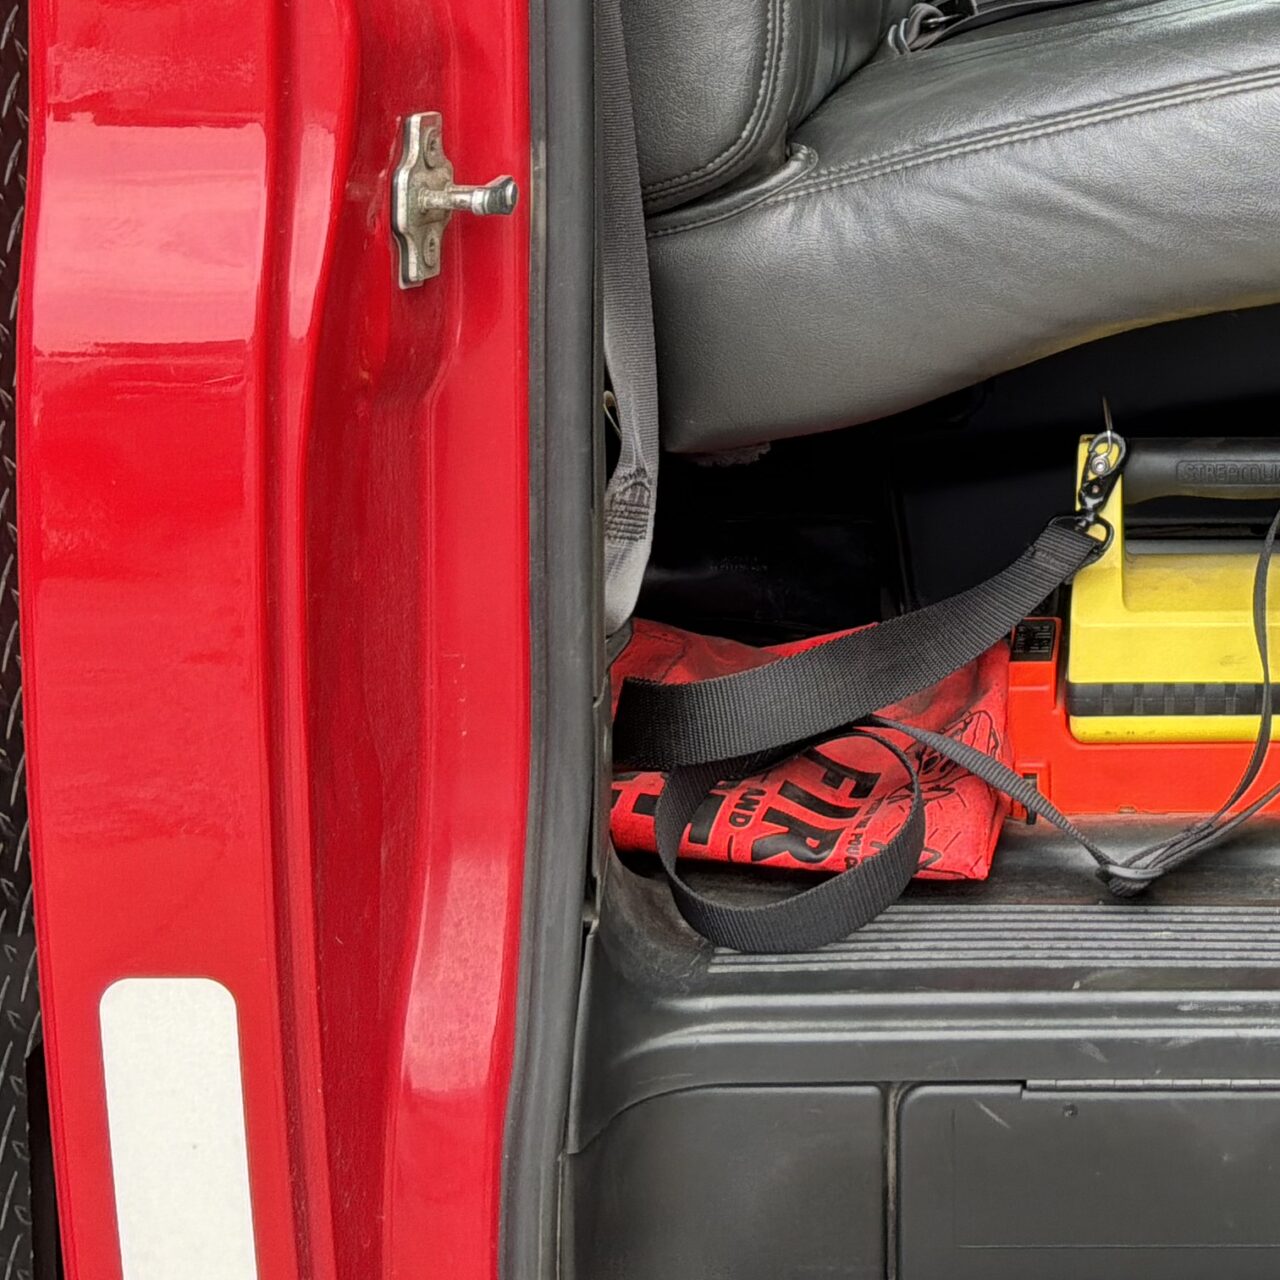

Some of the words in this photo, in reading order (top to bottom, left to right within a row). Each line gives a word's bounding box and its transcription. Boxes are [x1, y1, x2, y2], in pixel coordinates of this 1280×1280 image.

[728, 786, 767, 828] AND
[751, 746, 882, 863] FIR
[844, 832, 863, 869] POUC
